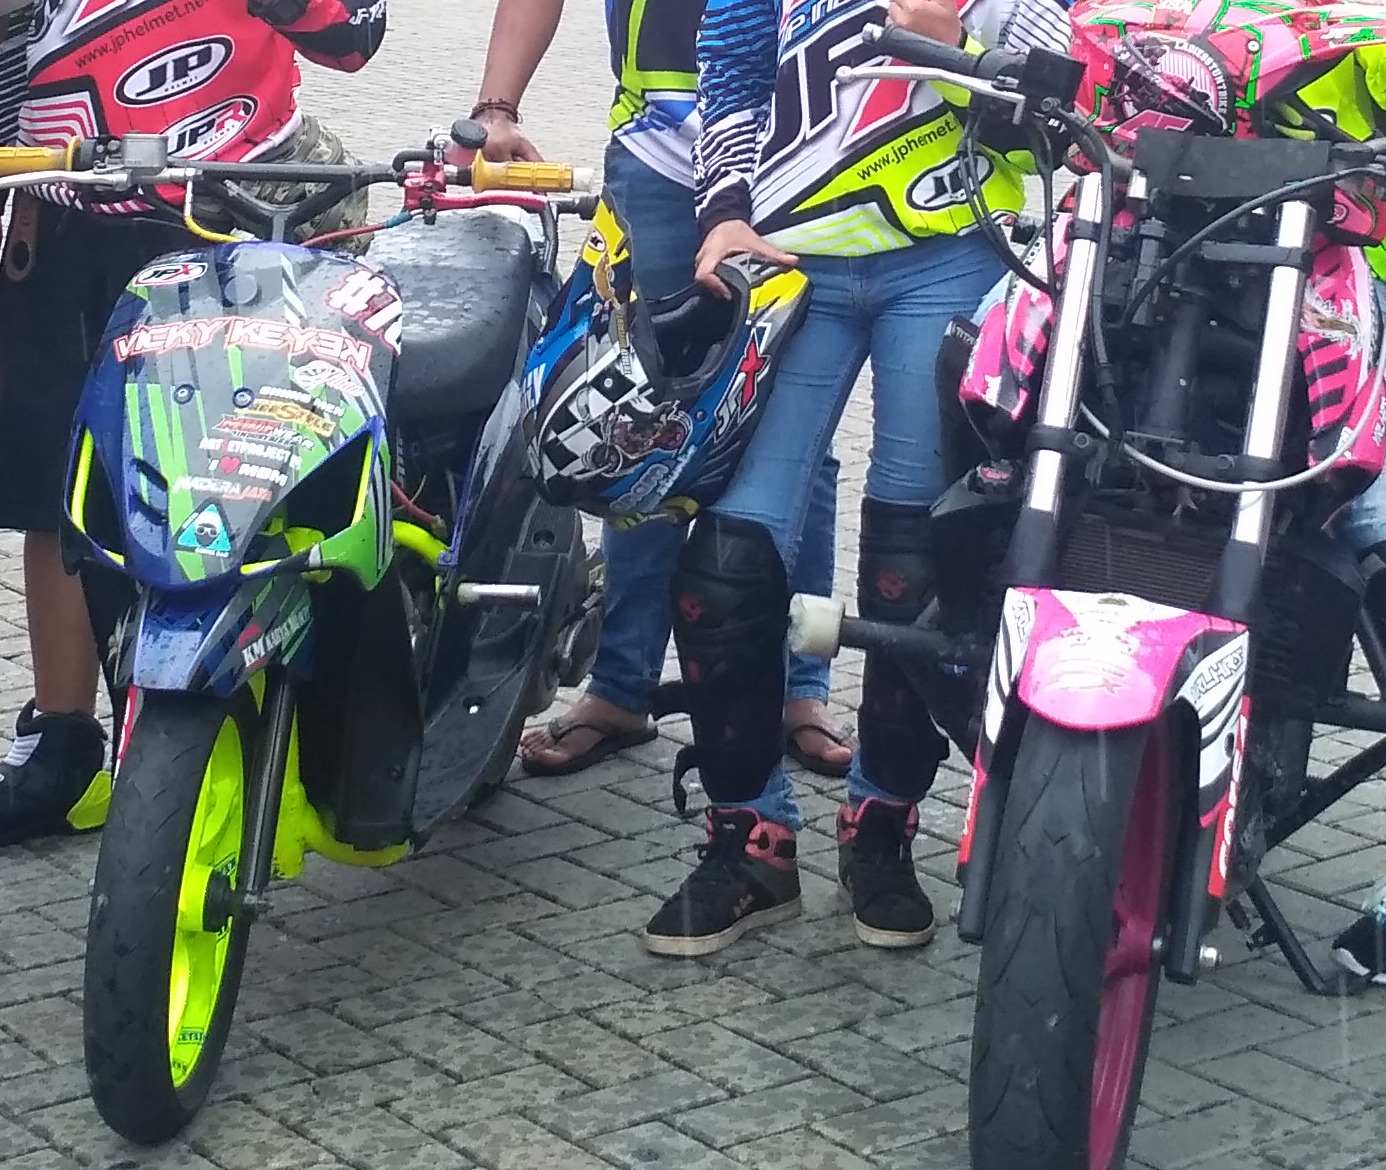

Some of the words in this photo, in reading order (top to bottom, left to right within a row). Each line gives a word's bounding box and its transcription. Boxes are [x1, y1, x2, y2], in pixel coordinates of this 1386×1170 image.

[134, 44, 213, 98] JP
[141, 264, 199, 281] JPX
[117, 320, 223, 361] VICKY
[238, 463, 288, 487] MOM
[241, 632, 266, 668] KM
